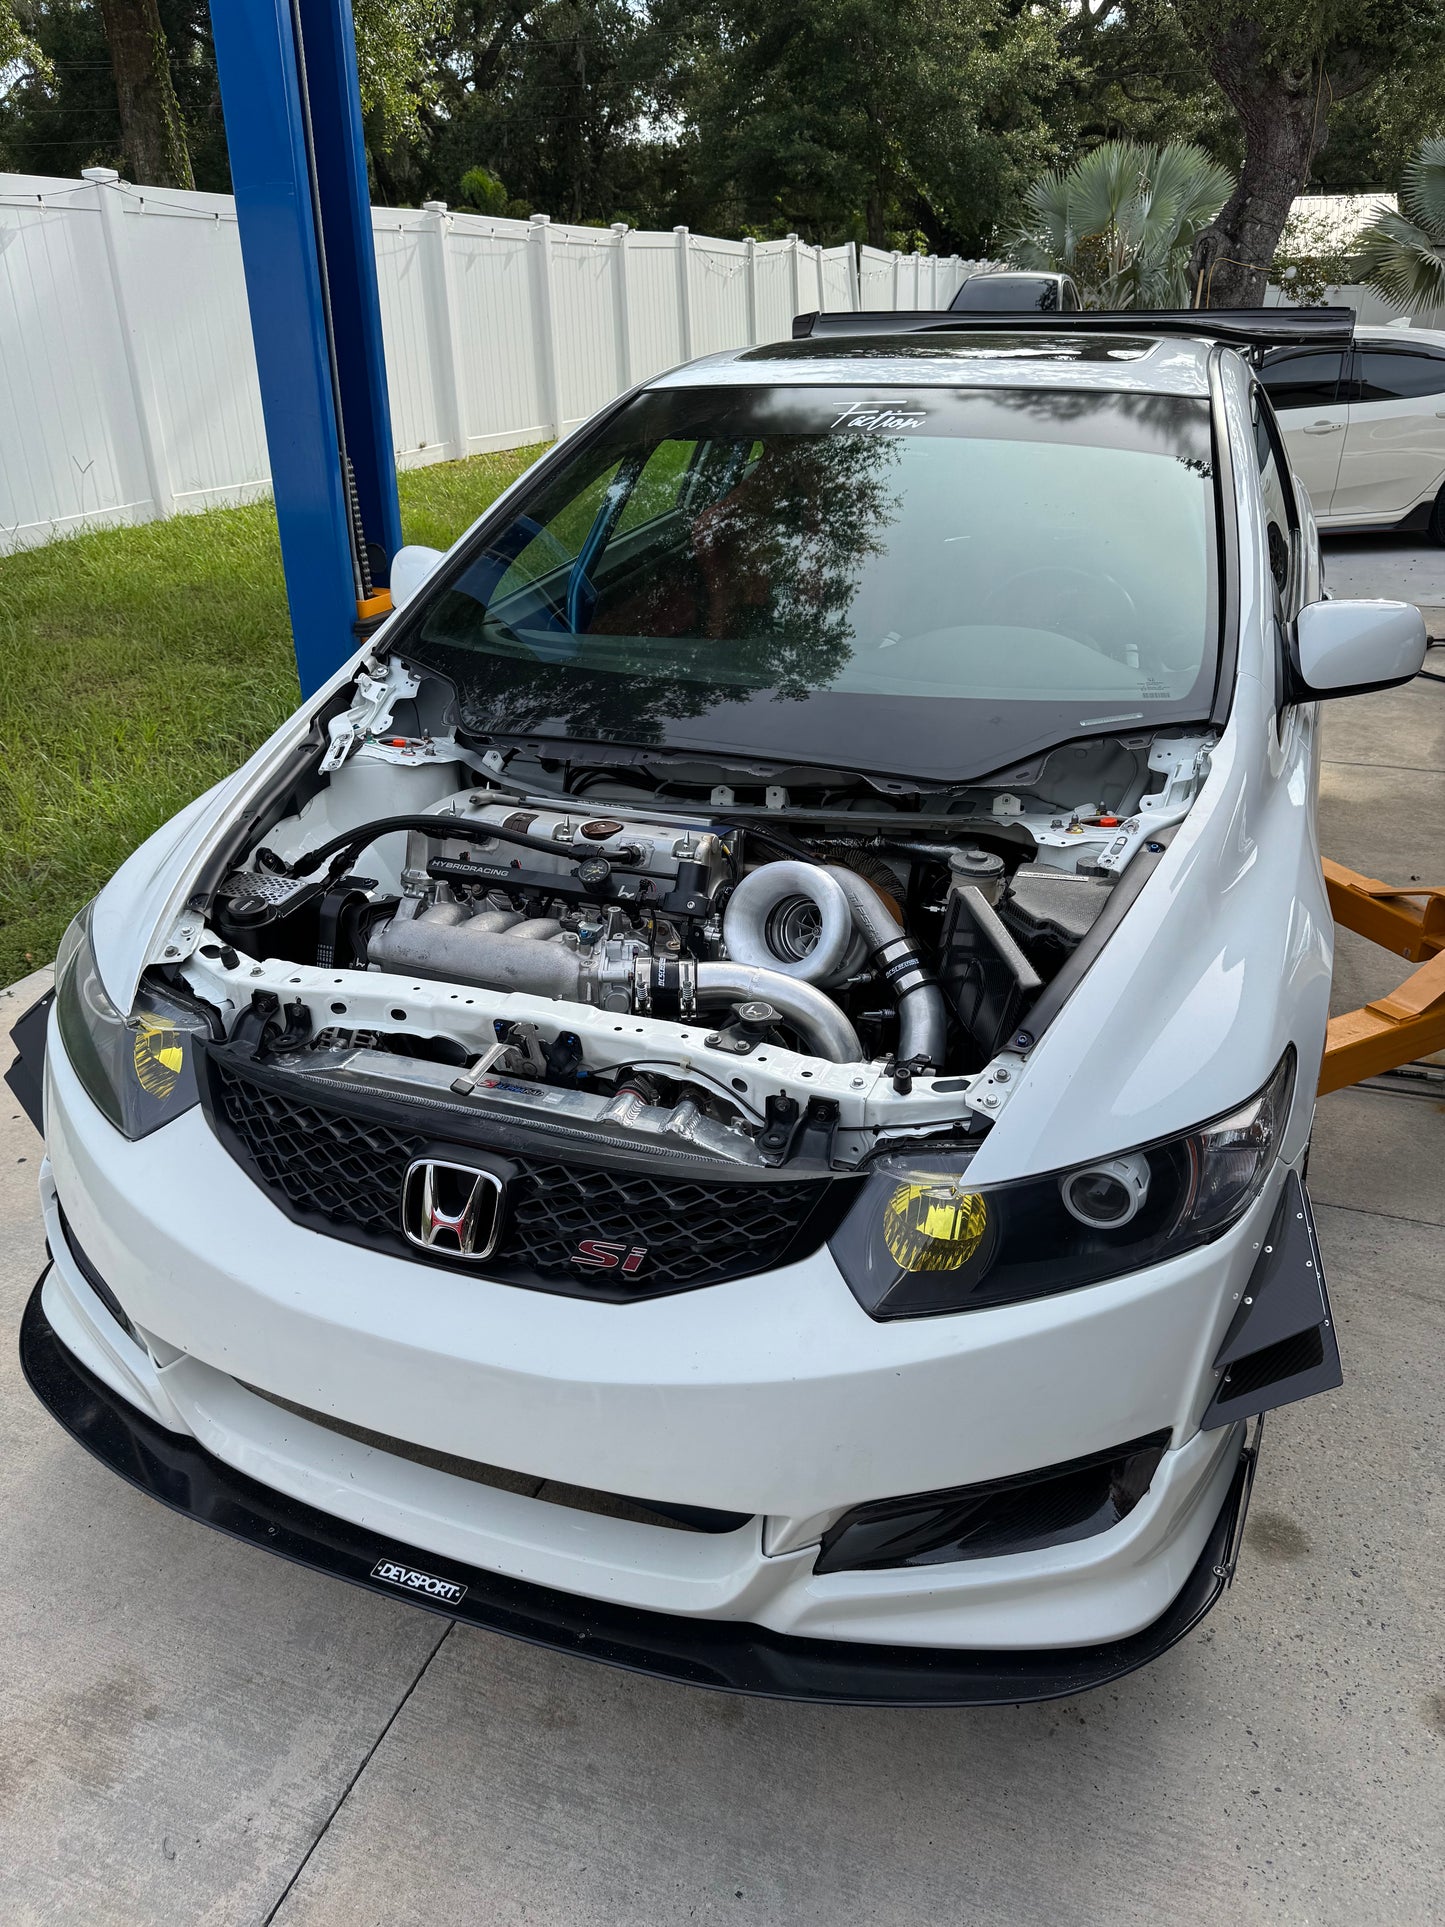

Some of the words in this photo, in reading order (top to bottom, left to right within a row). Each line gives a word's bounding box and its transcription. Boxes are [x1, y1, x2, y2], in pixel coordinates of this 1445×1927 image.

[831, 400, 927, 431] Faction
[431, 860, 510, 877] HYBRIDRACING
[570, 1239, 648, 1272] Si
[379, 1563, 460, 1598] DEVSPORT
